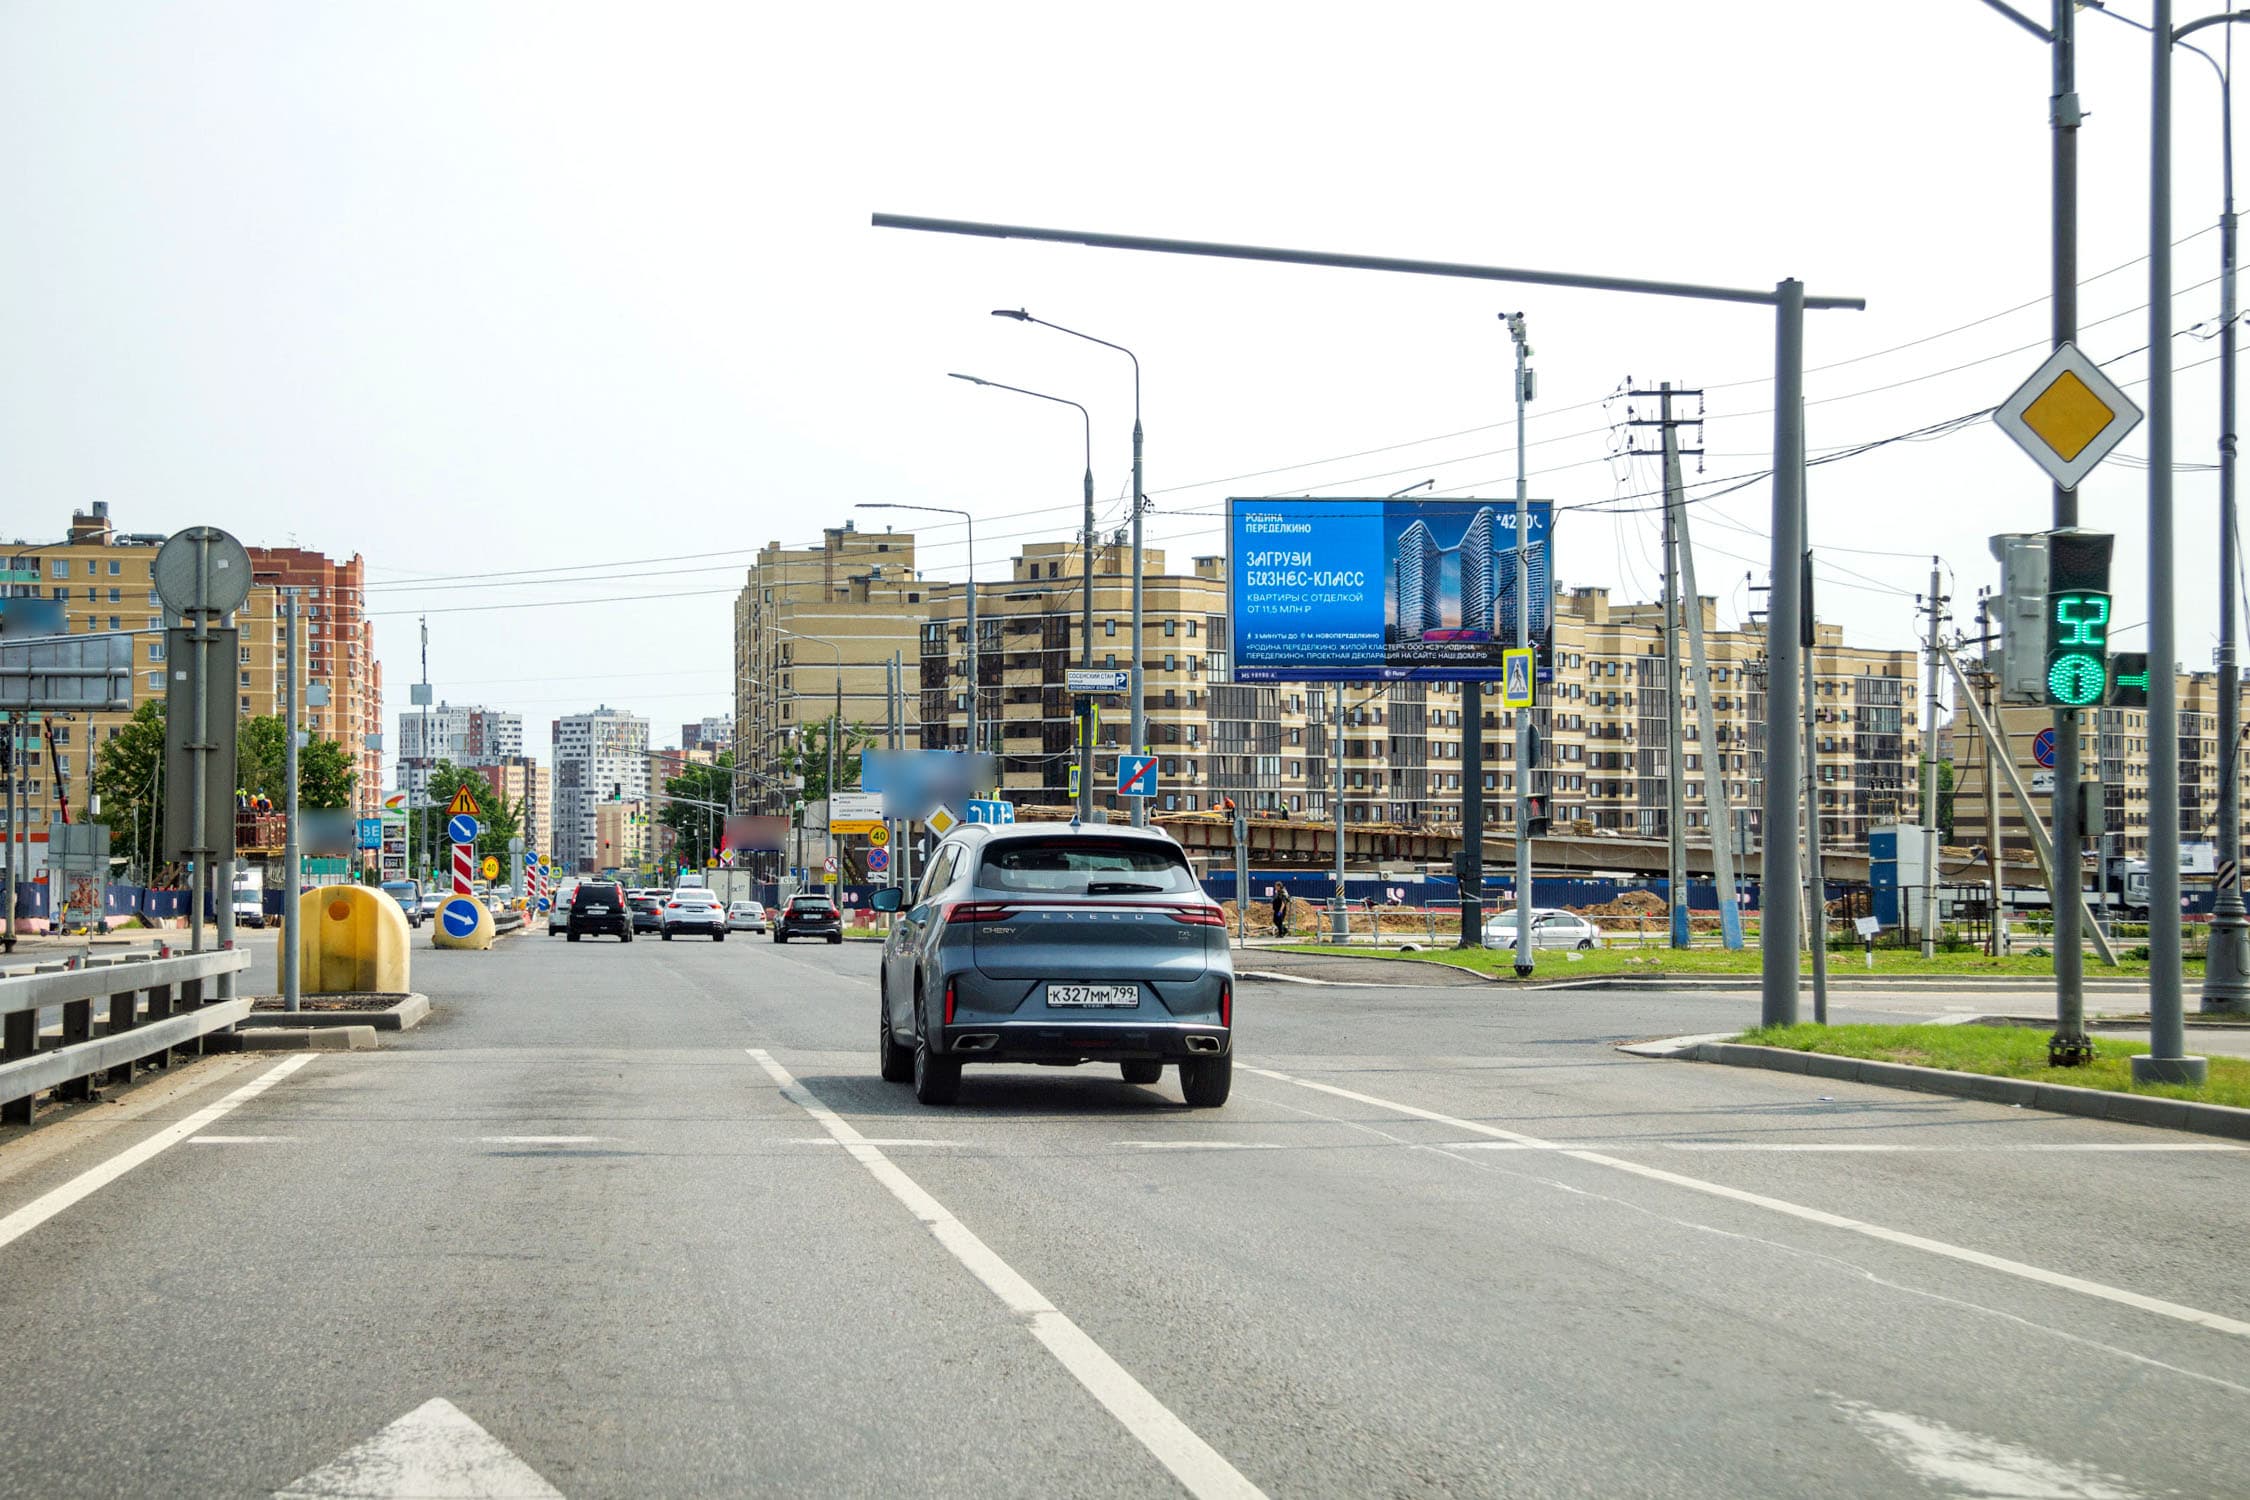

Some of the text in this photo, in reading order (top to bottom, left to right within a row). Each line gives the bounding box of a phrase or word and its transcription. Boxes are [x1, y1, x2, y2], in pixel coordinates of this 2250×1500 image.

[1245, 513, 1284, 524] РОДИНА
[1495, 513, 1534, 530] 420
[1245, 524, 1312, 534] ПЕРЕДЕЛКИНО
[1246, 551, 1312, 567] ЗАГРУЗИ
[1247, 571, 1365, 587] БИЗНЕС-КЛАСС
[1247, 592, 1364, 603] КВАРТИРЫ С ОТДЕЛКОЙ
[1247, 605, 1259, 614] ОТ
[1262, 605, 1278, 615] 11,5
[1279, 605, 1303, 614] МЛН
[2057, 597, 2109, 645] 52
[1339, 642, 1367, 650] ЖИЛОЙ
[1306, 652, 1350, 660] ПРОЕКТНАЯ
[1351, 652, 1400, 661] ДЕКЛАРАЦИЯ
[1401, 652, 1412, 660] НА
[1412, 651, 1437, 660] САЙТЕ
[872, 832, 886, 841] 40
[486, 864, 496, 873] 40
[1052, 987, 1134, 1002] К327ММ 799
